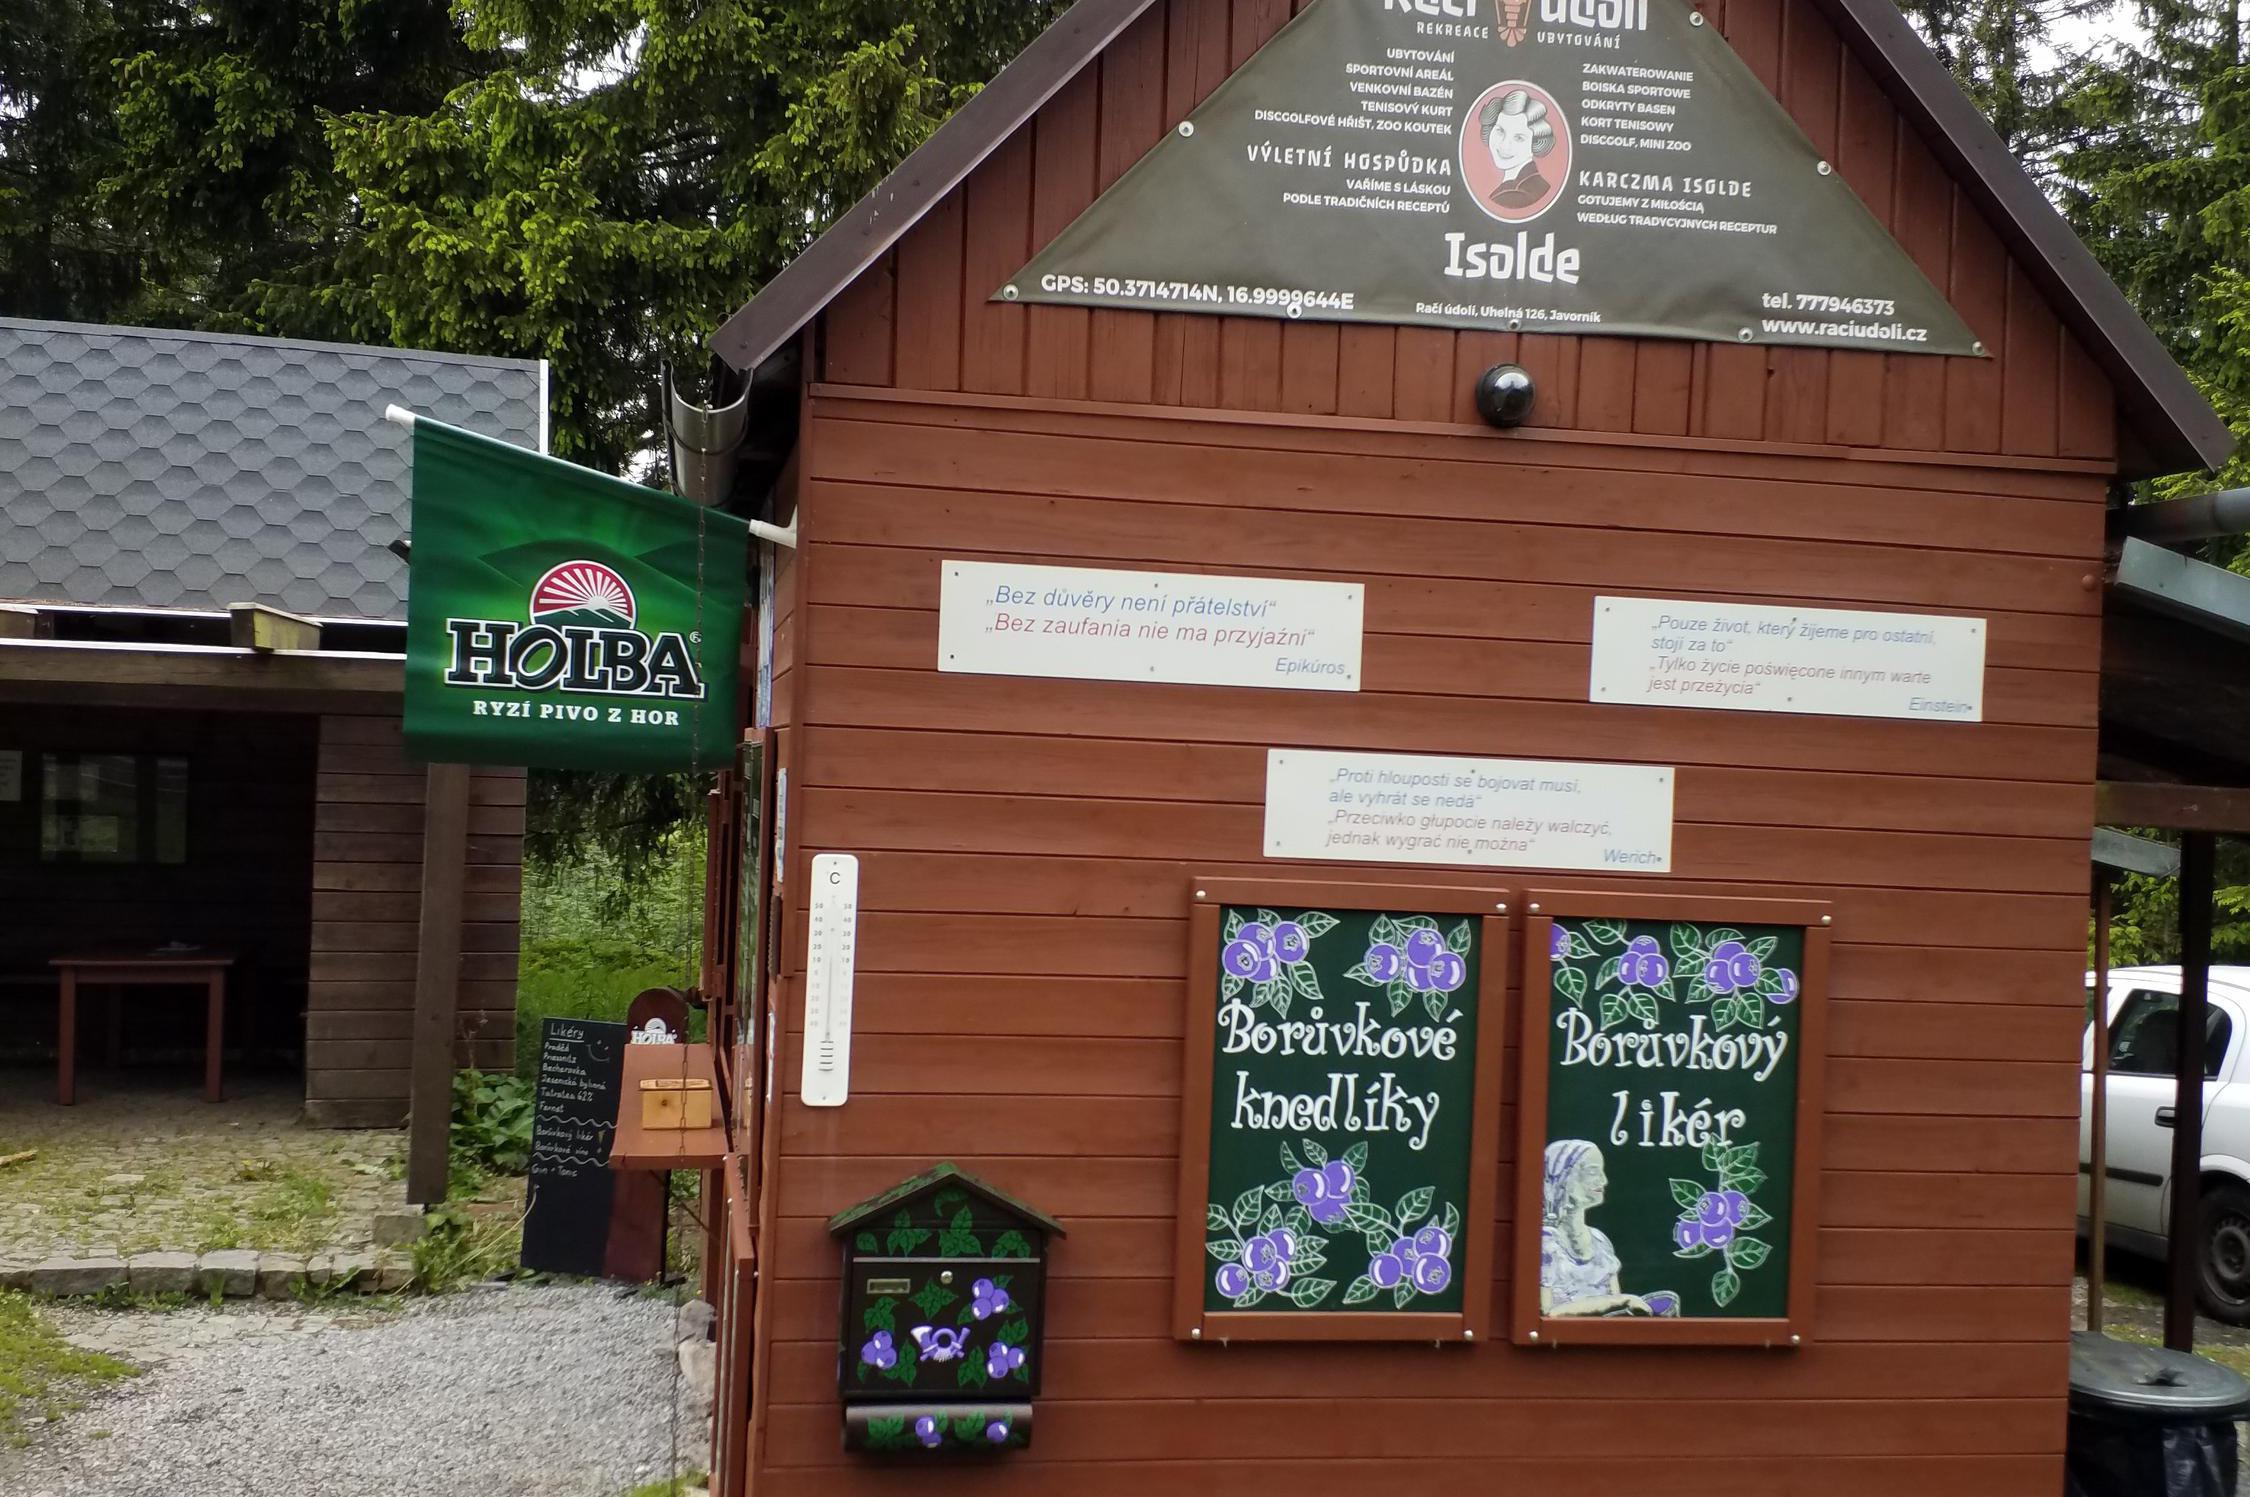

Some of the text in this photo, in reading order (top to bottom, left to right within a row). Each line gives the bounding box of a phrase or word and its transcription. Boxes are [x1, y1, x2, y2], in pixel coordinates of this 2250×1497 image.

[1416, 21, 1489, 39] REKREACE
[1537, 31, 1621, 49] UBYTOVÁNÍ
[1386, 48, 1455, 63] UBYTOVÁNÍ
[1346, 63, 1454, 81] SPORTOVNÍ AREÁL
[1582, 63, 1694, 82] ZAKWATEROWANIE
[1350, 81, 1453, 99] VENKOVNÍ BAZÉN
[1582, 81, 1691, 99] BOISKA SPORTOWE
[1361, 100, 1453, 117] TENISOVÝ KURT
[1581, 99, 1676, 116] ODKRYTY BASEN
[1254, 109, 1335, 127] DISCGOLFOVÉ
[1376, 119, 1402, 132] ZOO
[1404, 123, 1452, 135] KOUTEK
[1581, 116, 1674, 133] KORT TENISOWY
[1580, 134, 1692, 151] DISCGOLF, MINI ZOO
[1247, 140, 1451, 176] VÝLETNÍ HOSPŮDKA
[1346, 178, 1451, 196] VAŘÍME S LÁSKOU
[1579, 170, 1752, 197] KARCZMA ISOLDE
[1283, 192, 1321, 205] PODLE
[1323, 195, 1395, 210] TRADIČNÍCH
[1577, 195, 1704, 214] GOTUJEMY Z MIŁOŚCIĄ
[1577, 212, 1777, 235] WEDŁUG TRADYCYJNYCH RECEPTUR
[1444, 231, 1580, 285] Isolde
[1041, 274, 1354, 310] GPS: 50.3714714N, 16.9999644E
[1416, 302, 1442, 314] Račí
[1480, 306, 1523, 319] Uhelná
[1525, 308, 1548, 320] 126,
[1549, 309, 1601, 323] Javorník
[1762, 292, 1895, 316] tel. 777946373
[1762, 319, 1927, 342] www.raciudoli.cz
[1043, 588, 1115, 614] důvěry
[1121, 594, 1167, 612] není
[1042, 617, 1131, 638] zaufania
[1138, 621, 1169, 640] nie
[1176, 626, 1207, 641] ma
[1757, 621, 1796, 639] který
[1799, 623, 1849, 640] žijeme
[1852, 629, 1878, 643] pro
[1688, 640, 1706, 651] za
[444, 618, 705, 698] HOLBA
[1275, 657, 1345, 675] Epikúros
[1701, 659, 1740, 676] życie
[1744, 661, 1835, 680] poświęcone
[1839, 666, 1885, 684] innym
[1890, 670, 1931, 684] warte
[1647, 677, 1677, 693] jest
[473, 700, 679, 726] RYZÍ PIVO Z HOR
[1909, 697, 1968, 713] Einstein
[1377, 770, 1449, 787] hlouposti
[1454, 777, 1472, 788] se
[1477, 775, 1535, 792] bojovat
[1329, 790, 1353, 803] ale
[1358, 791, 1407, 807] vyhrát
[1411, 795, 1430, 806] se
[1491, 817, 1543, 834] należy
[1325, 829, 1381, 847] jednak
[1386, 834, 1442, 850] wygrać
[1446, 836, 1470, 849] nie
[1603, 849, 1656, 864] Werich
[830, 872, 840, 884] C
[550, 1023, 584, 1039] Likéry
[1218, 998, 1464, 1061] Borůvkové
[1556, 1006, 1790, 1082] Borůvkový
[1230, 1070, 1440, 1150] knedlíky
[1609, 1090, 1747, 1148] likér
